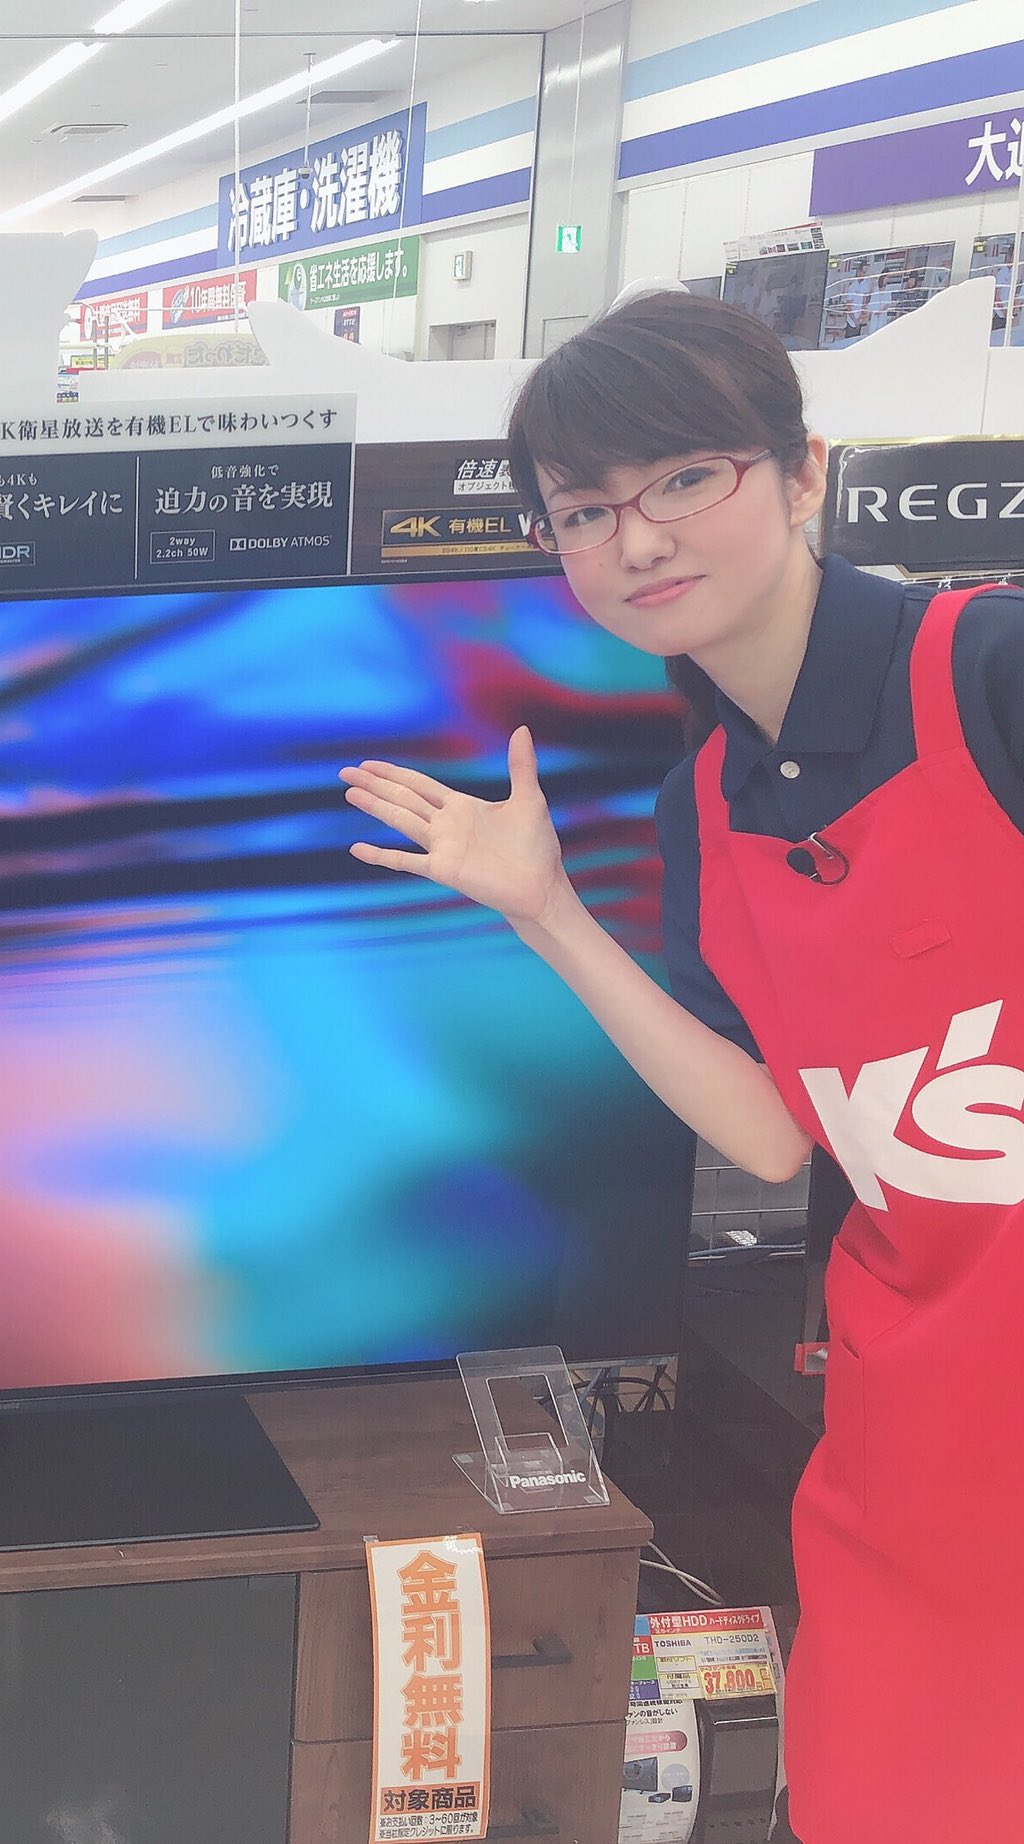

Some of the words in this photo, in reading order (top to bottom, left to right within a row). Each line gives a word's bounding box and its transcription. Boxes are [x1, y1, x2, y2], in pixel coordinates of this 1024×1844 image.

[227, 129, 404, 252] 冷蔵庫・洗濯機
[309, 247, 408, 292] 省エネ生活を応援します。
[210, 463, 279, 479] 低音強化で
[154, 480, 334, 516] 迫力の音を実現
[390, 515, 442, 538] 4K
[448, 517, 512, 534] 有機EL
[169, 536, 196, 547] 2way
[248, 537, 289, 549] DOLBY
[290, 535, 331, 547] ATMOS
[156, 549, 183, 558] 2.2ch
[187, 547, 209, 557] 50W
[509, 1469, 587, 1489] Panasonic
[650, 1615, 708, 1629] 外付型HDD
[655, 1639, 692, 1647] TOSHIBA
[396, 1549, 465, 1782] 金利無料
[383, 1786, 476, 1812] 対象商品
